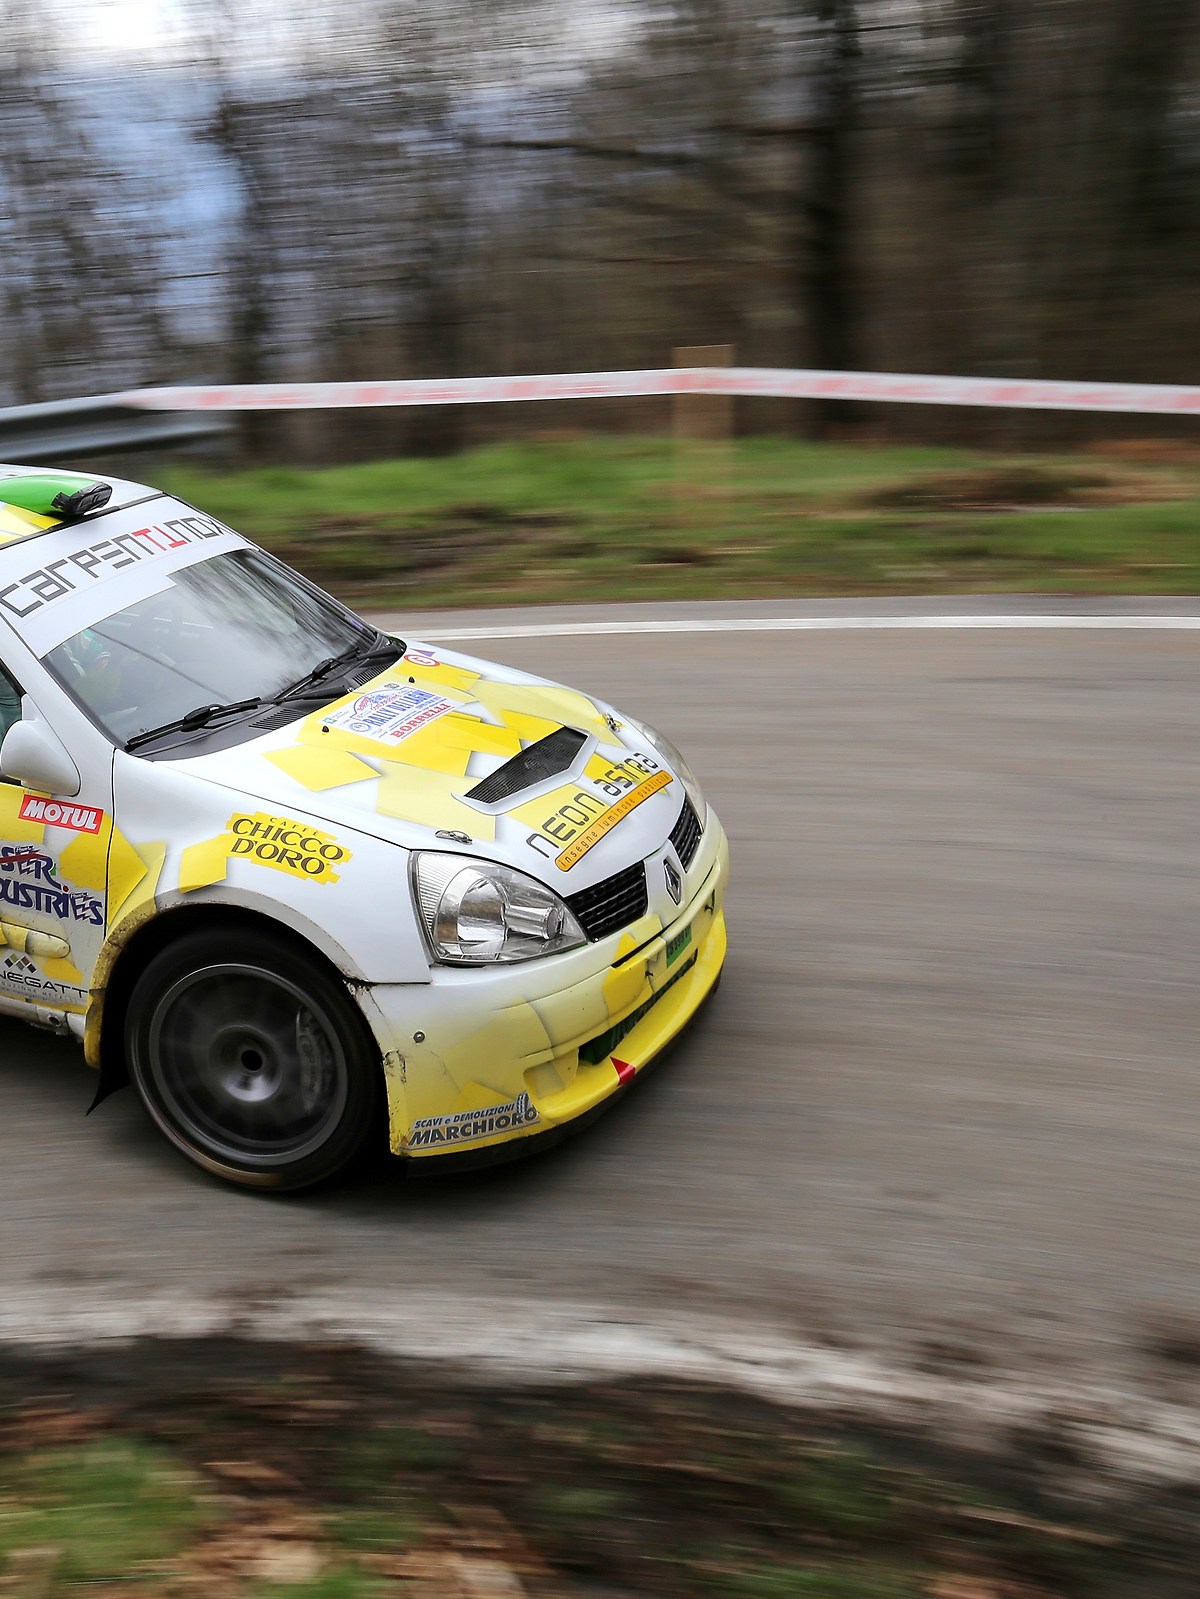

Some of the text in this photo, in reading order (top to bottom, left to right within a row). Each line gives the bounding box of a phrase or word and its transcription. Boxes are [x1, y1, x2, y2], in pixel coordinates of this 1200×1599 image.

[388, 702, 451, 738] BORRELLI
[23, 799, 98, 830] MOTUL
[526, 752, 659, 859] NEON ASTRA
[232, 818, 344, 860] CHICCO
[558, 831, 598, 868] insegne
[597, 798, 635, 830] luminose
[230, 837, 325, 875] D'ORO
[408, 1107, 537, 1146] MARCHIORO
[414, 1117, 442, 1129] SCAVI
[453, 1103, 515, 1123] DEMOLIZIONI
